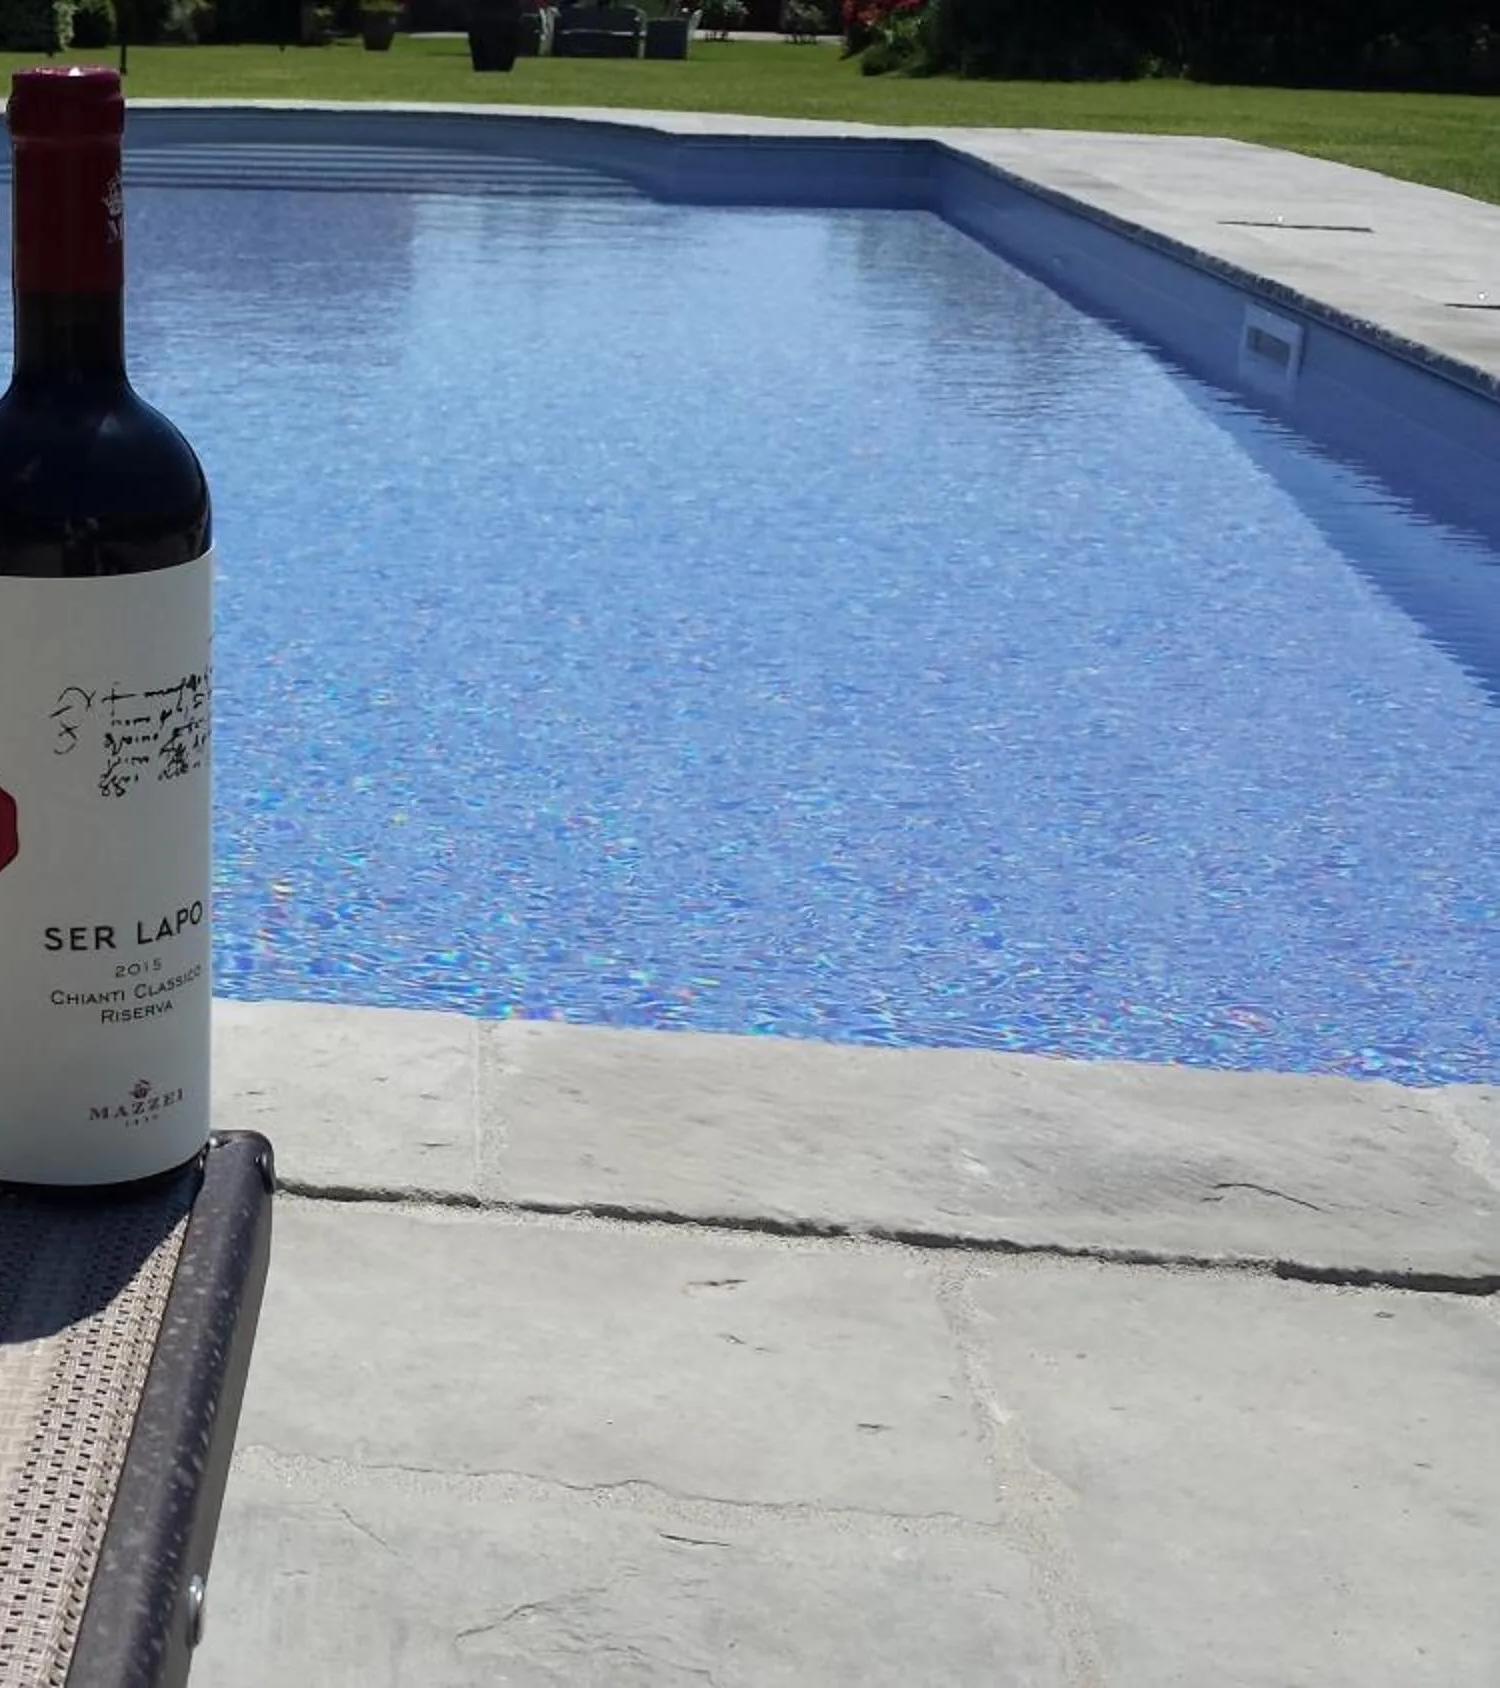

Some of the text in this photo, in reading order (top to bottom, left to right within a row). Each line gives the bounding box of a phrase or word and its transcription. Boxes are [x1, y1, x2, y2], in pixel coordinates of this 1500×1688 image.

[43, 900, 203, 951] SER LAPO
[115, 958, 163, 978] 2015
[89, 1088, 182, 1120] MAZZEI
